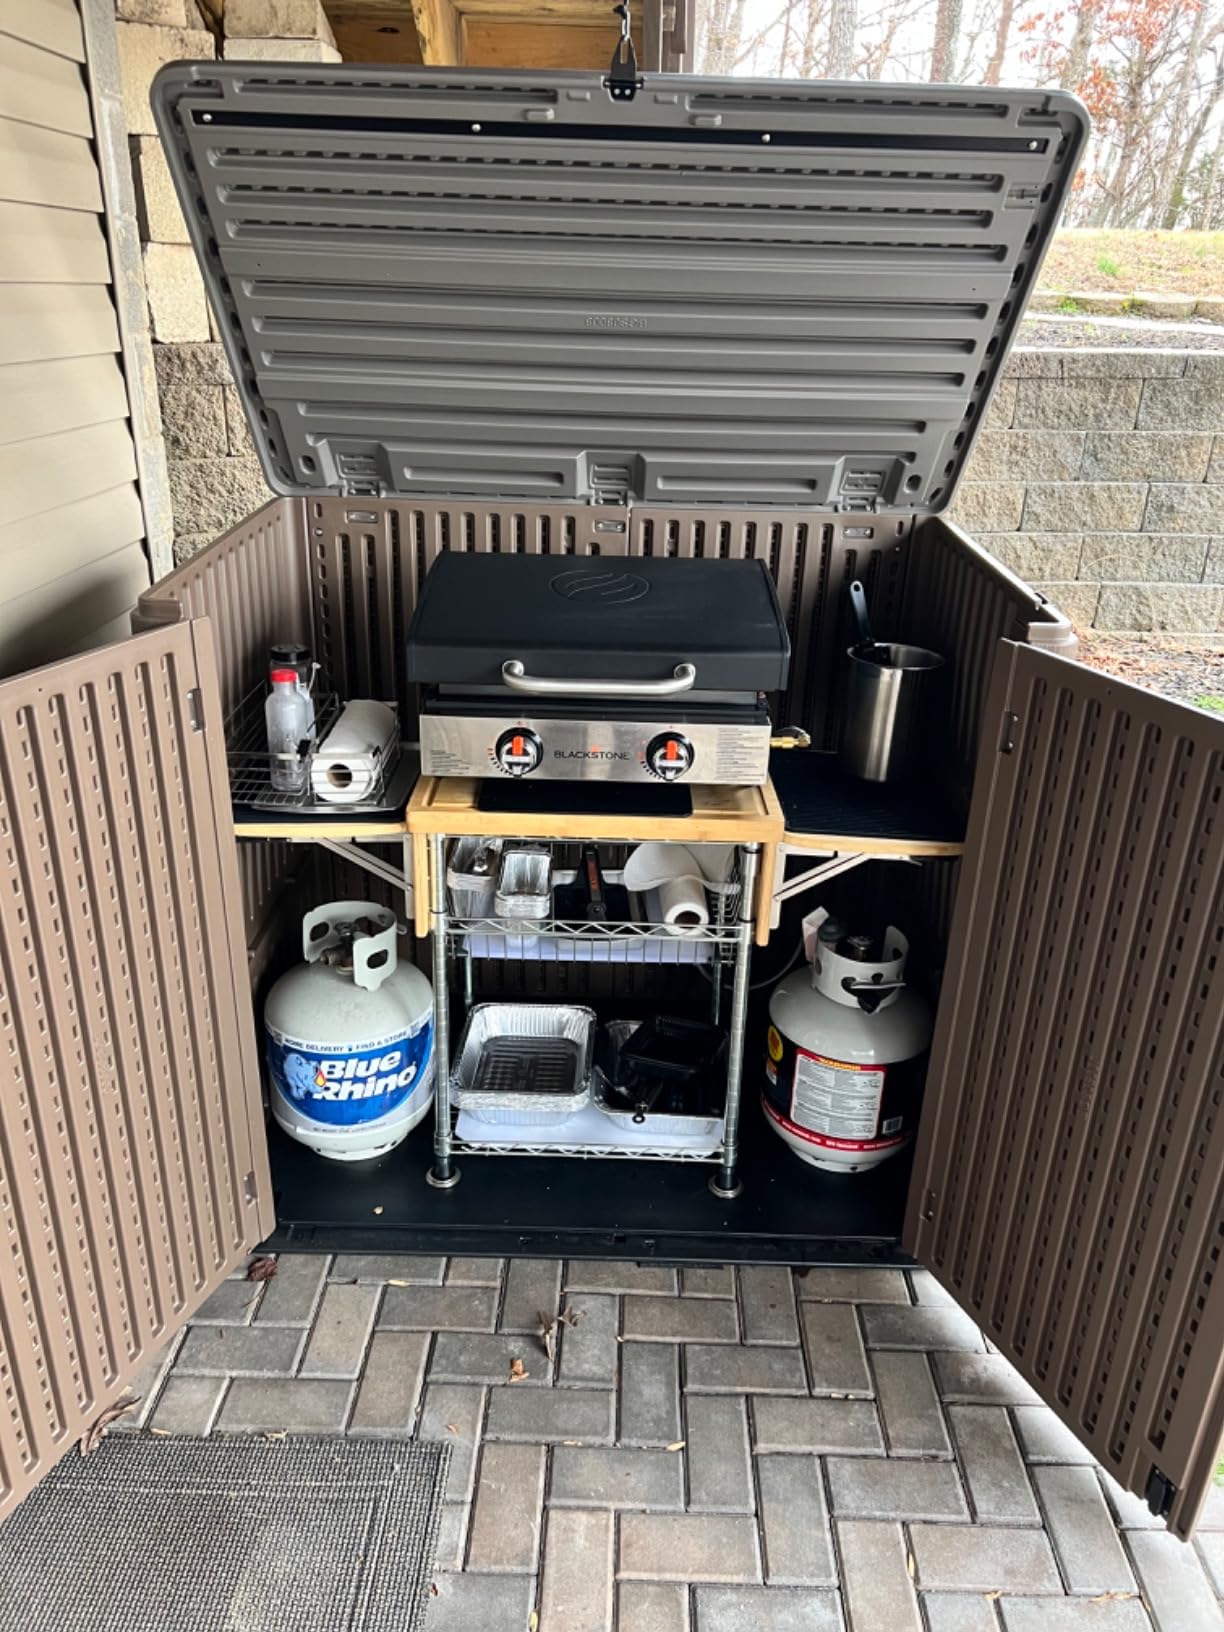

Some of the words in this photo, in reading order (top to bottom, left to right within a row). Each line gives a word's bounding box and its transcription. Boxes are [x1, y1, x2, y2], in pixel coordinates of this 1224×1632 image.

[553, 748, 631, 761] BLACKSTONE
[284, 1038, 304, 1049] HOME
[305, 1043, 344, 1053] DELIVERY
[355, 1042, 375, 1051] FIND
[384, 1031, 407, 1043] STORE
[320, 1050, 402, 1079] Blue
[312, 1065, 417, 1101] Rhino
